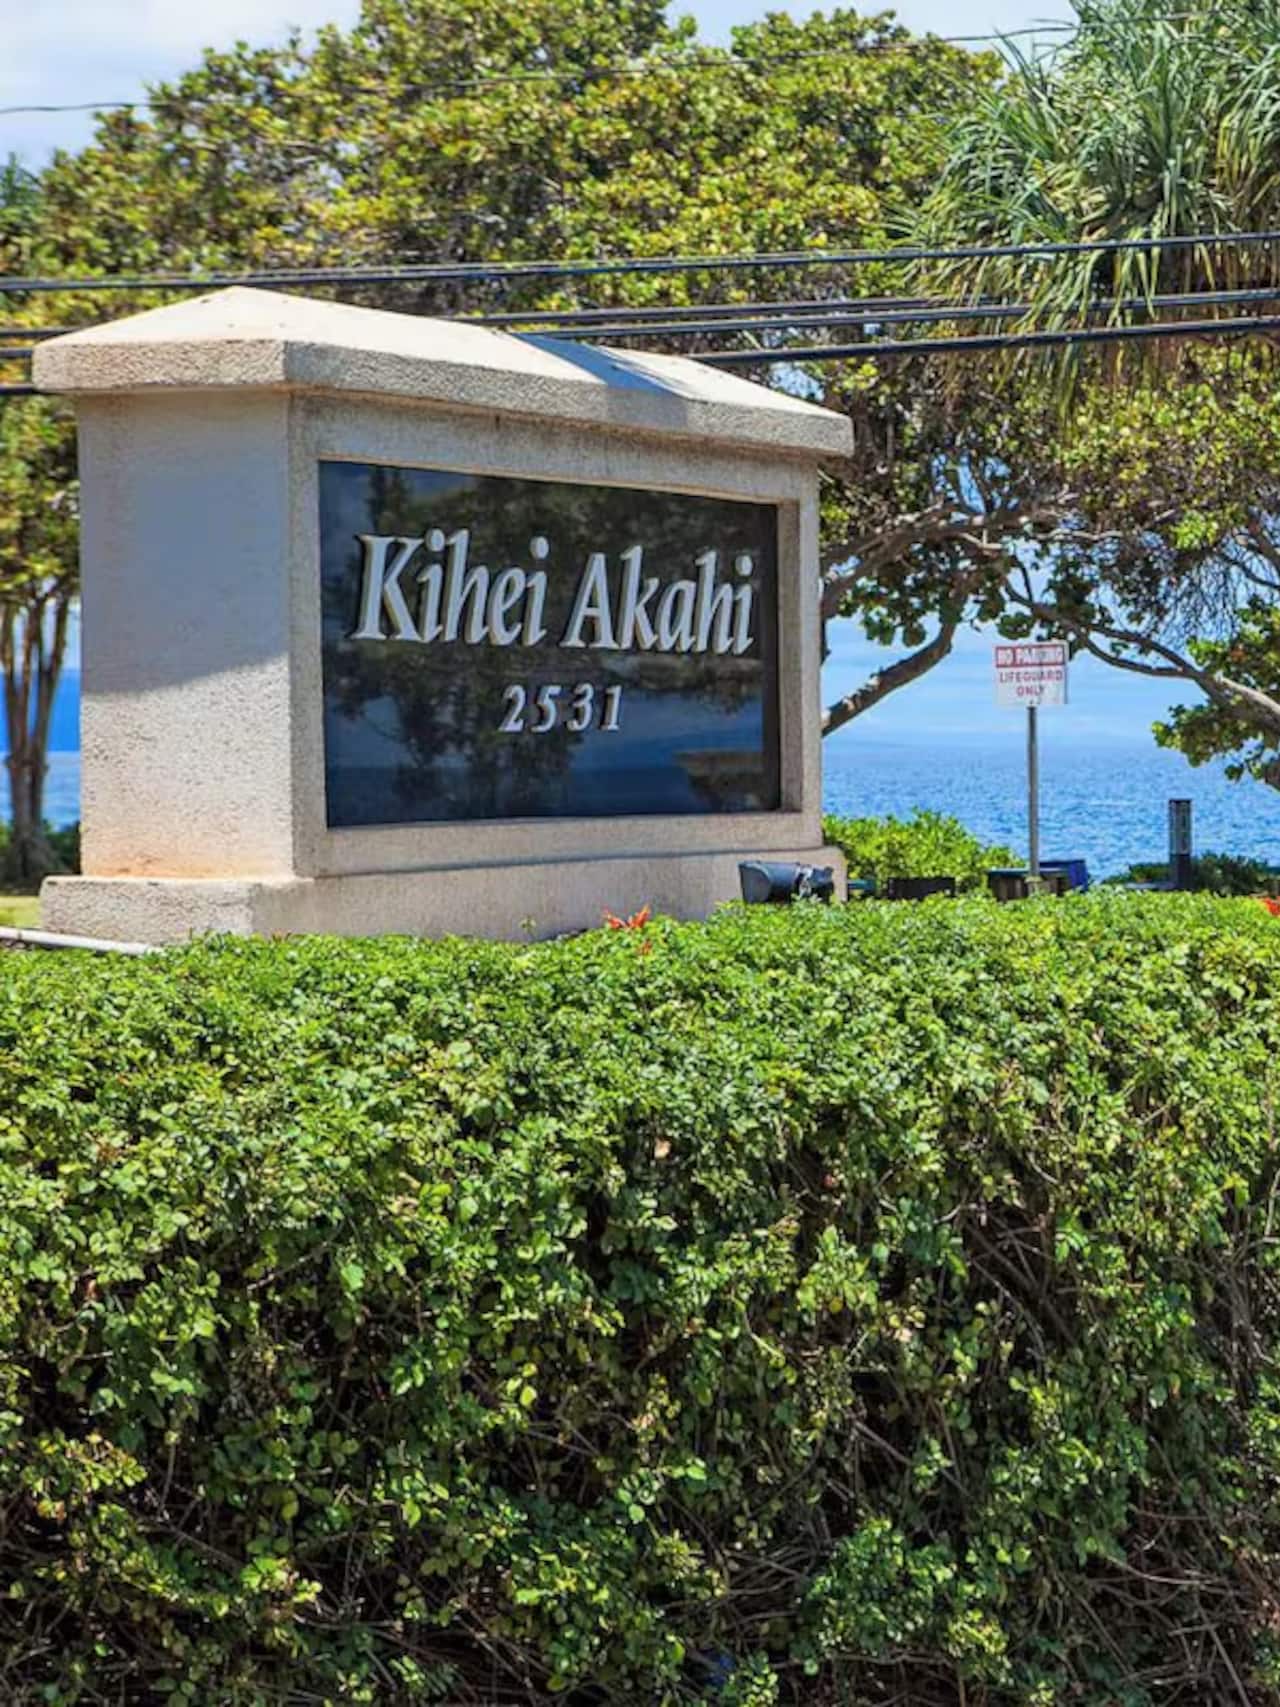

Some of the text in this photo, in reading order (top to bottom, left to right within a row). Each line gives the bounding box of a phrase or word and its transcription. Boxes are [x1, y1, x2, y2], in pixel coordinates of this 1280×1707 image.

[352, 528, 755, 655] Kihei Akahi
[1000, 670, 1063, 683] LIFEGUARD
[1016, 685, 1044, 697] ONLY
[499, 682, 623, 734] 2531
